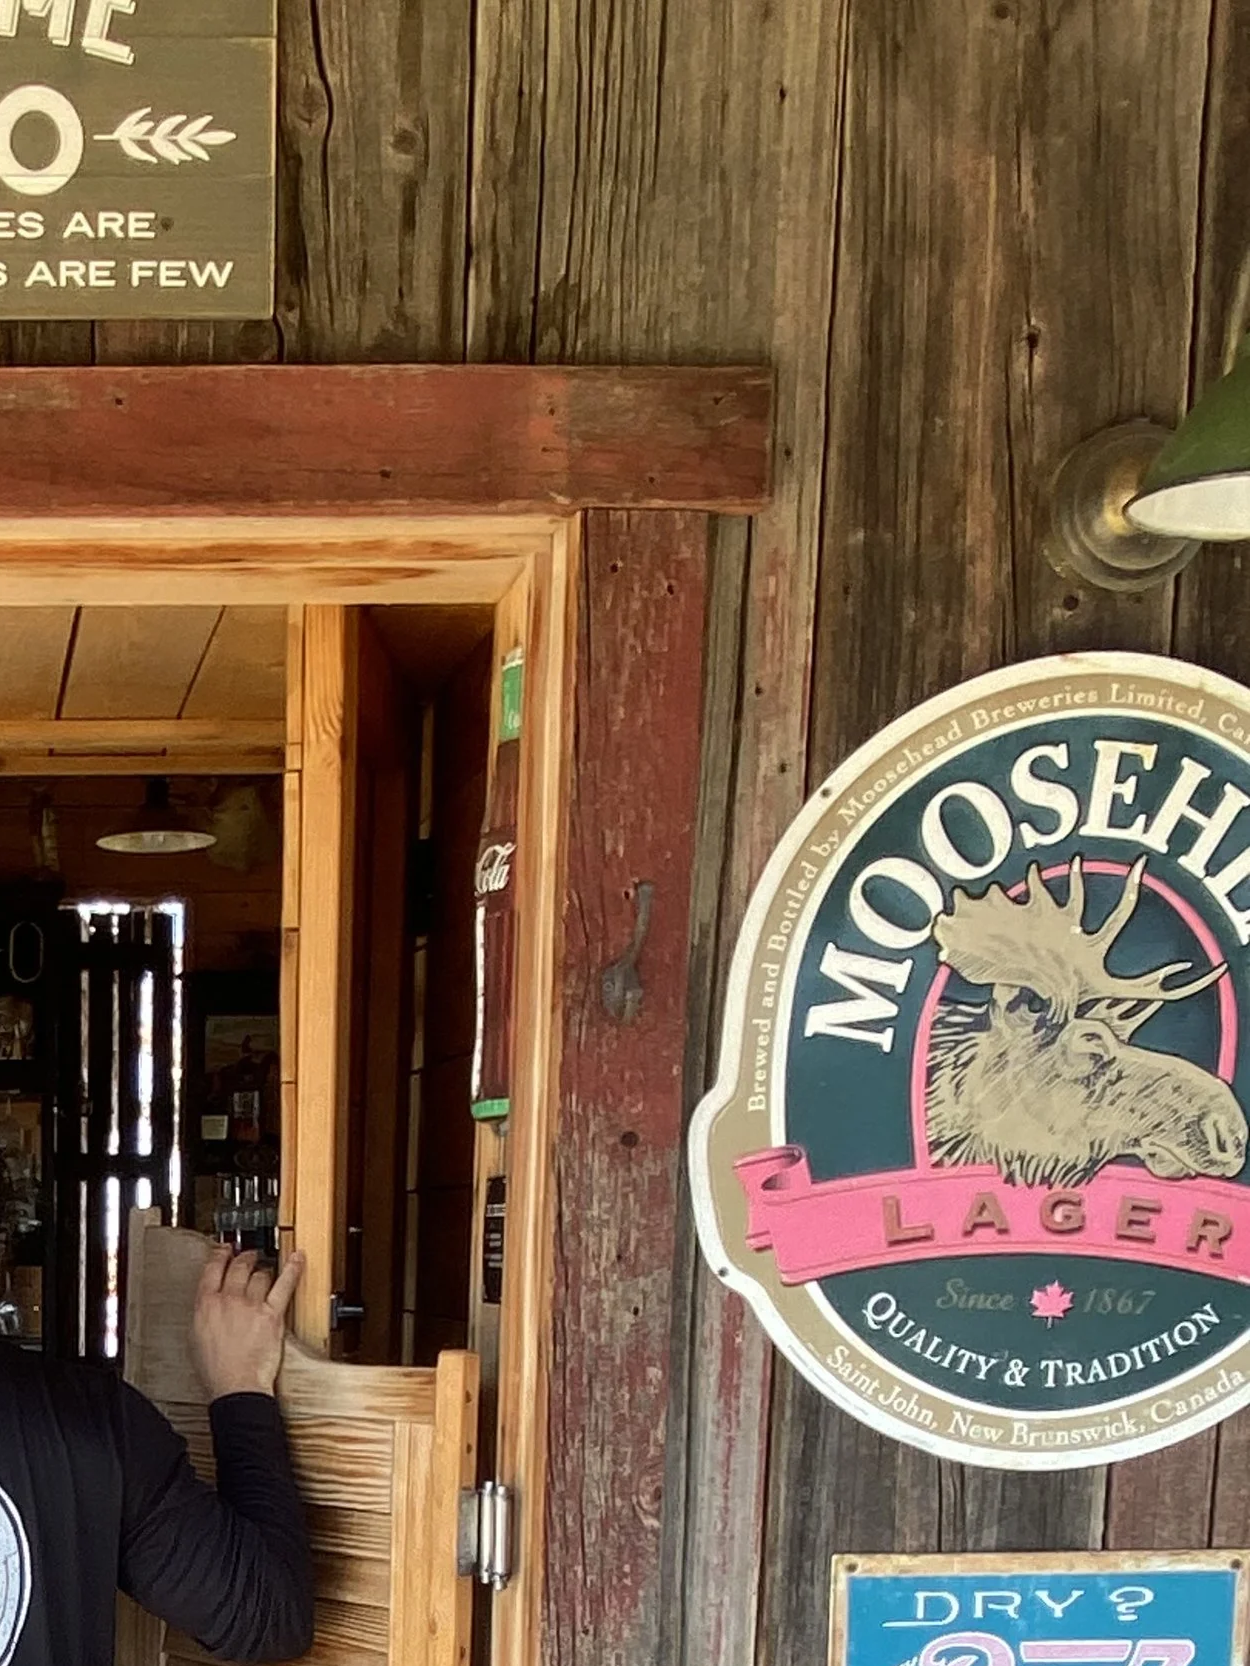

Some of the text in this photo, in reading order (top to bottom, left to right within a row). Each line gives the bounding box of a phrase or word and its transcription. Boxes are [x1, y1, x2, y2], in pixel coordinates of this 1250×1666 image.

[62, 211, 157, 241] ARE
[23, 259, 117, 289] ARE
[131, 259, 234, 289] FEW
[747, 683, 1250, 1113] Brewed and Bottled by Moosehead Breweries Limited, Ca
[882, 1190, 1234, 1260] LAGER
[936, 1278, 1157, 1316] Since 1867
[861, 1291, 1222, 1389] QUALITY & TRADITION
[826, 1343, 1248, 1448] Saint John, New Brunswick, Canada
